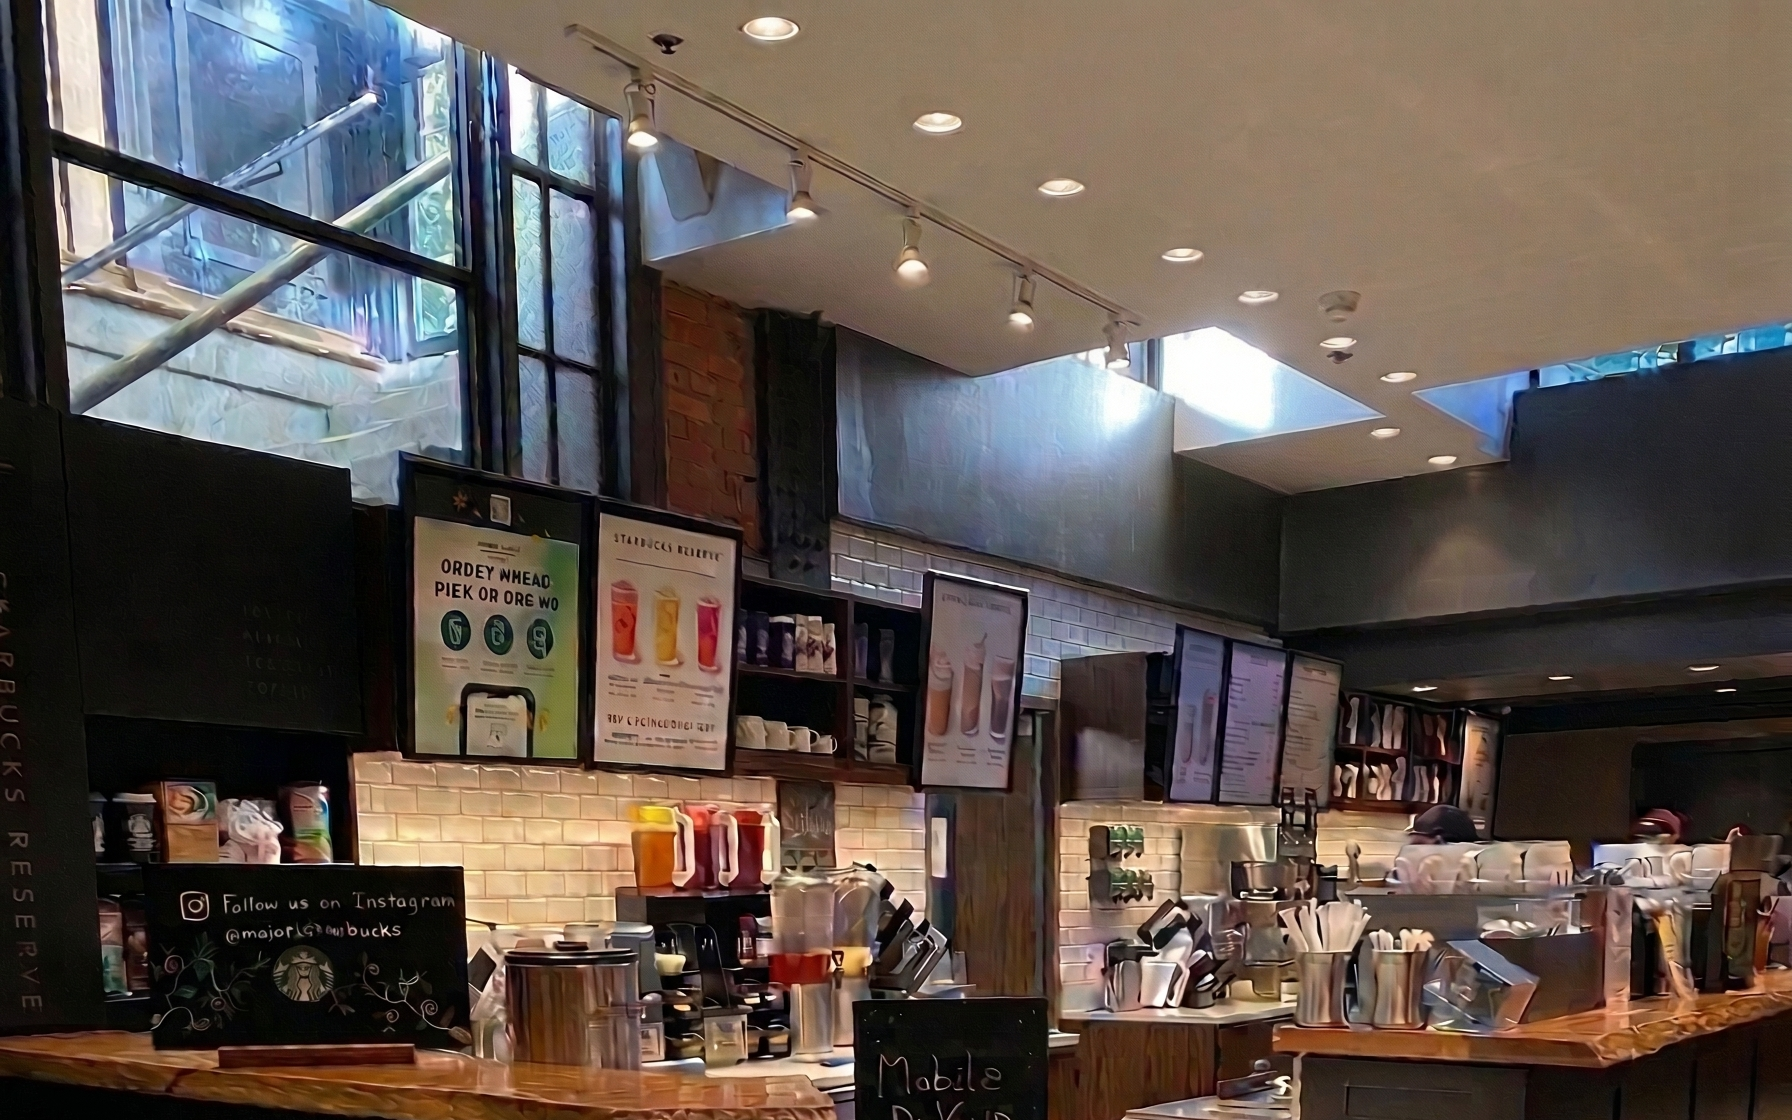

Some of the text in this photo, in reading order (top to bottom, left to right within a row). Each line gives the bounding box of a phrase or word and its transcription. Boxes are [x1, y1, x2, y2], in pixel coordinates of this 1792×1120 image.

[478, 586, 499, 603] OR
[8, 831, 44, 1011] RESERVE
[222, 890, 456, 916] Follow us on Instagram
[878, 1050, 1003, 1099] Mobile
